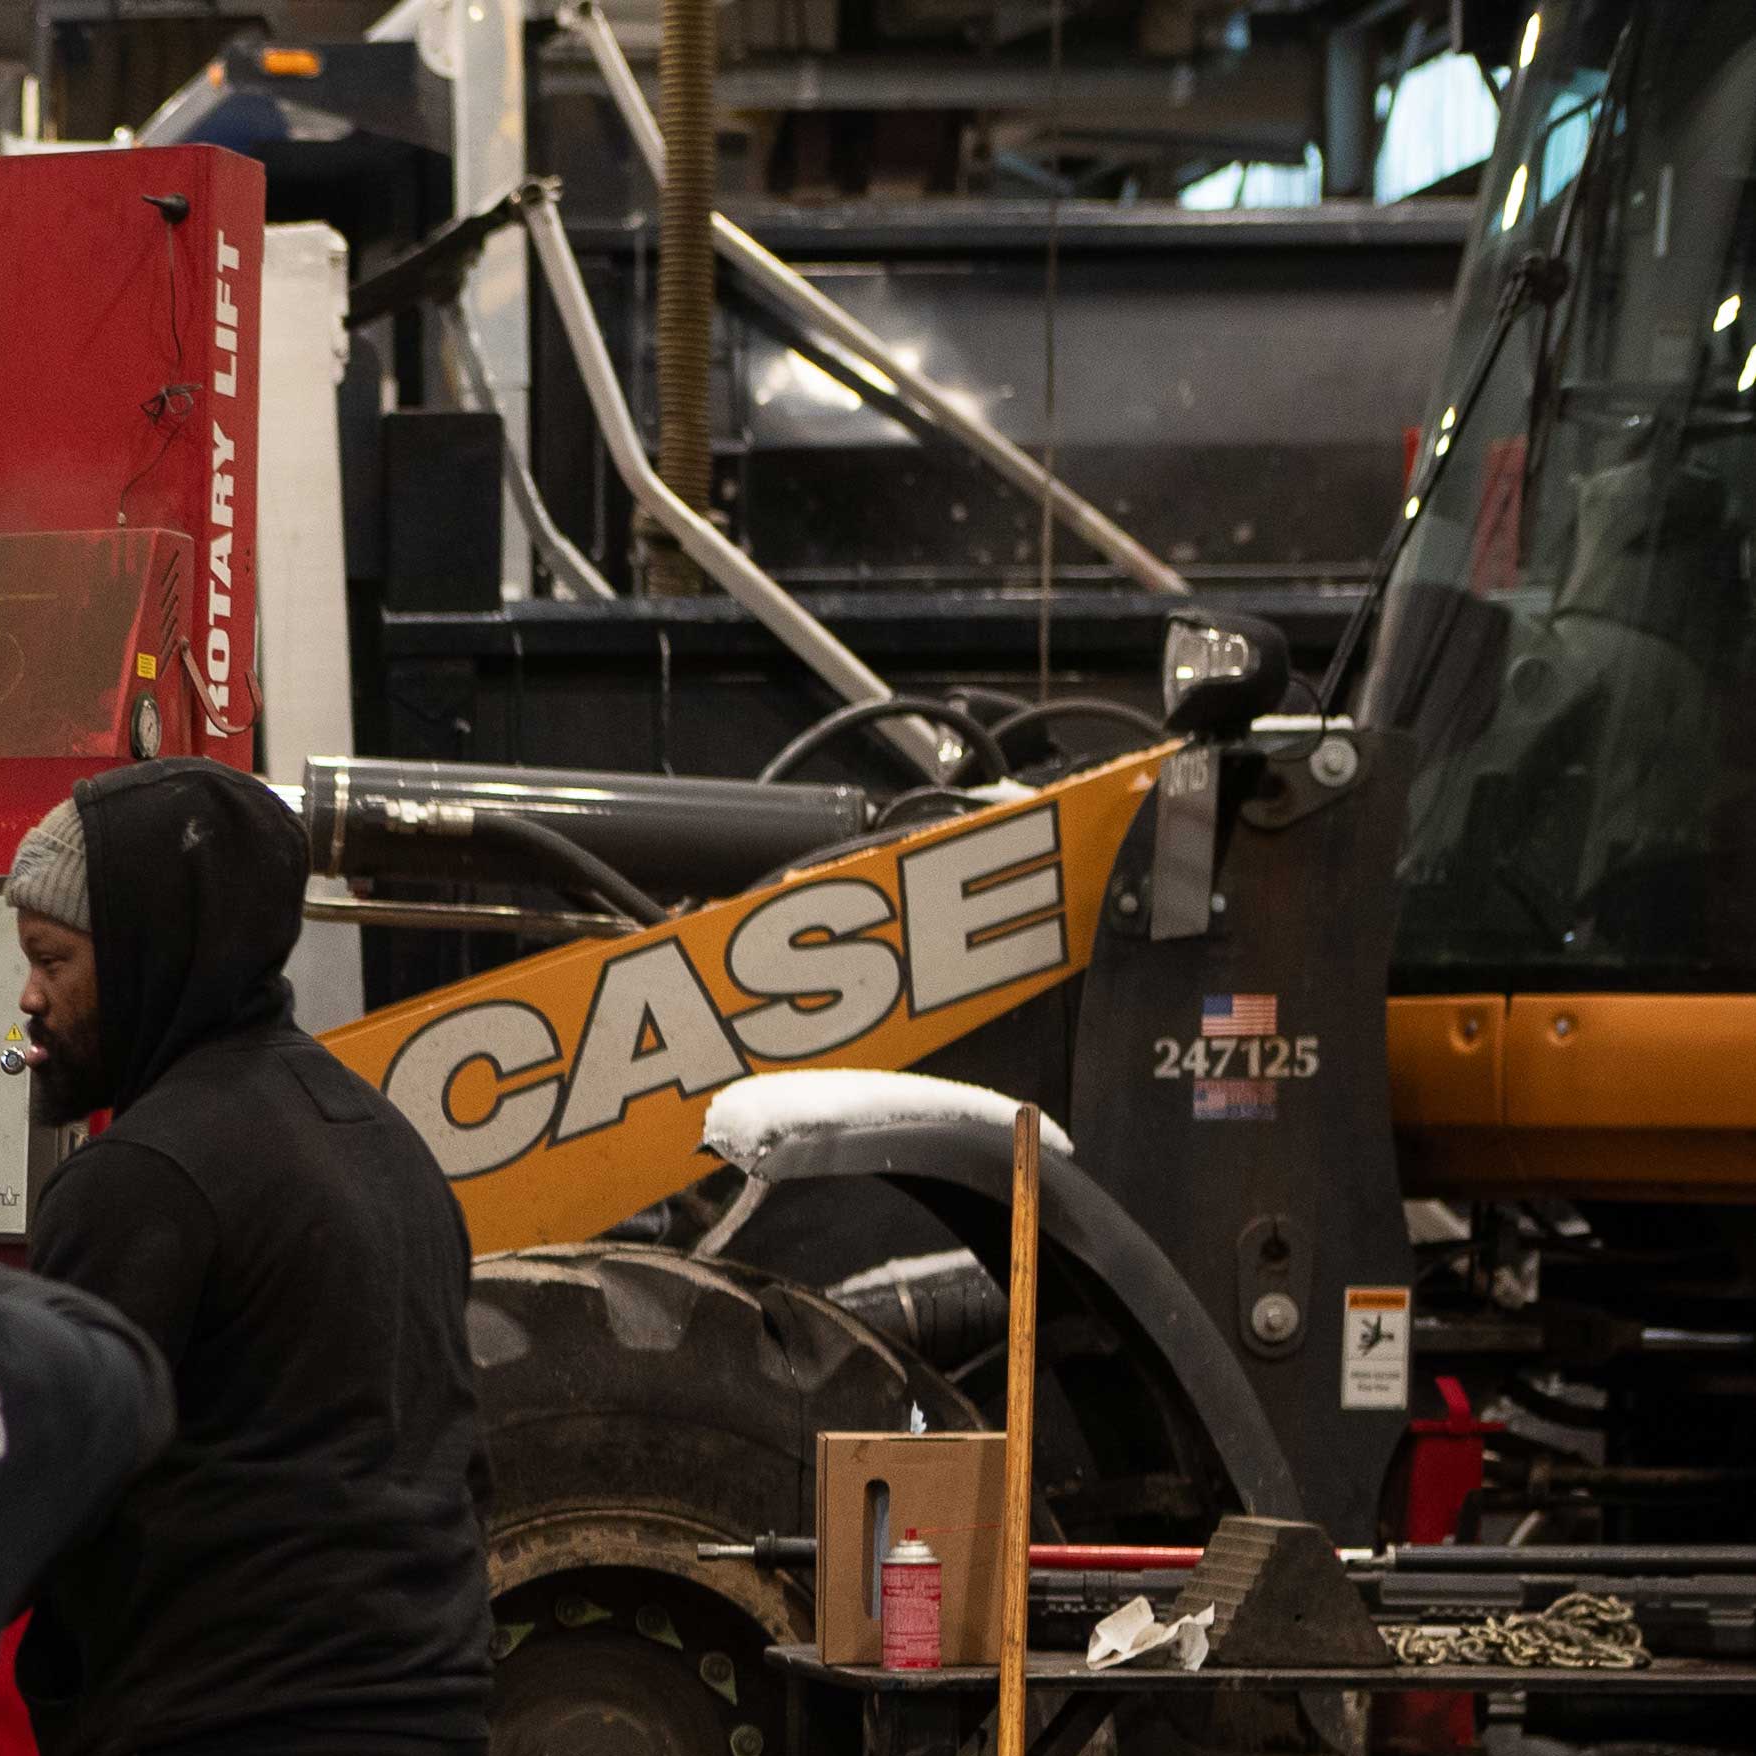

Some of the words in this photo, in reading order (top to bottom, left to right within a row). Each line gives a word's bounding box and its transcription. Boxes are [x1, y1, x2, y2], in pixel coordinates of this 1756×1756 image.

[213, 229, 244, 399] LIFT
[204, 418, 237, 738] ROTARY
[382, 802, 1069, 1180] CASE
[1152, 1035, 1321, 1080] 247125
